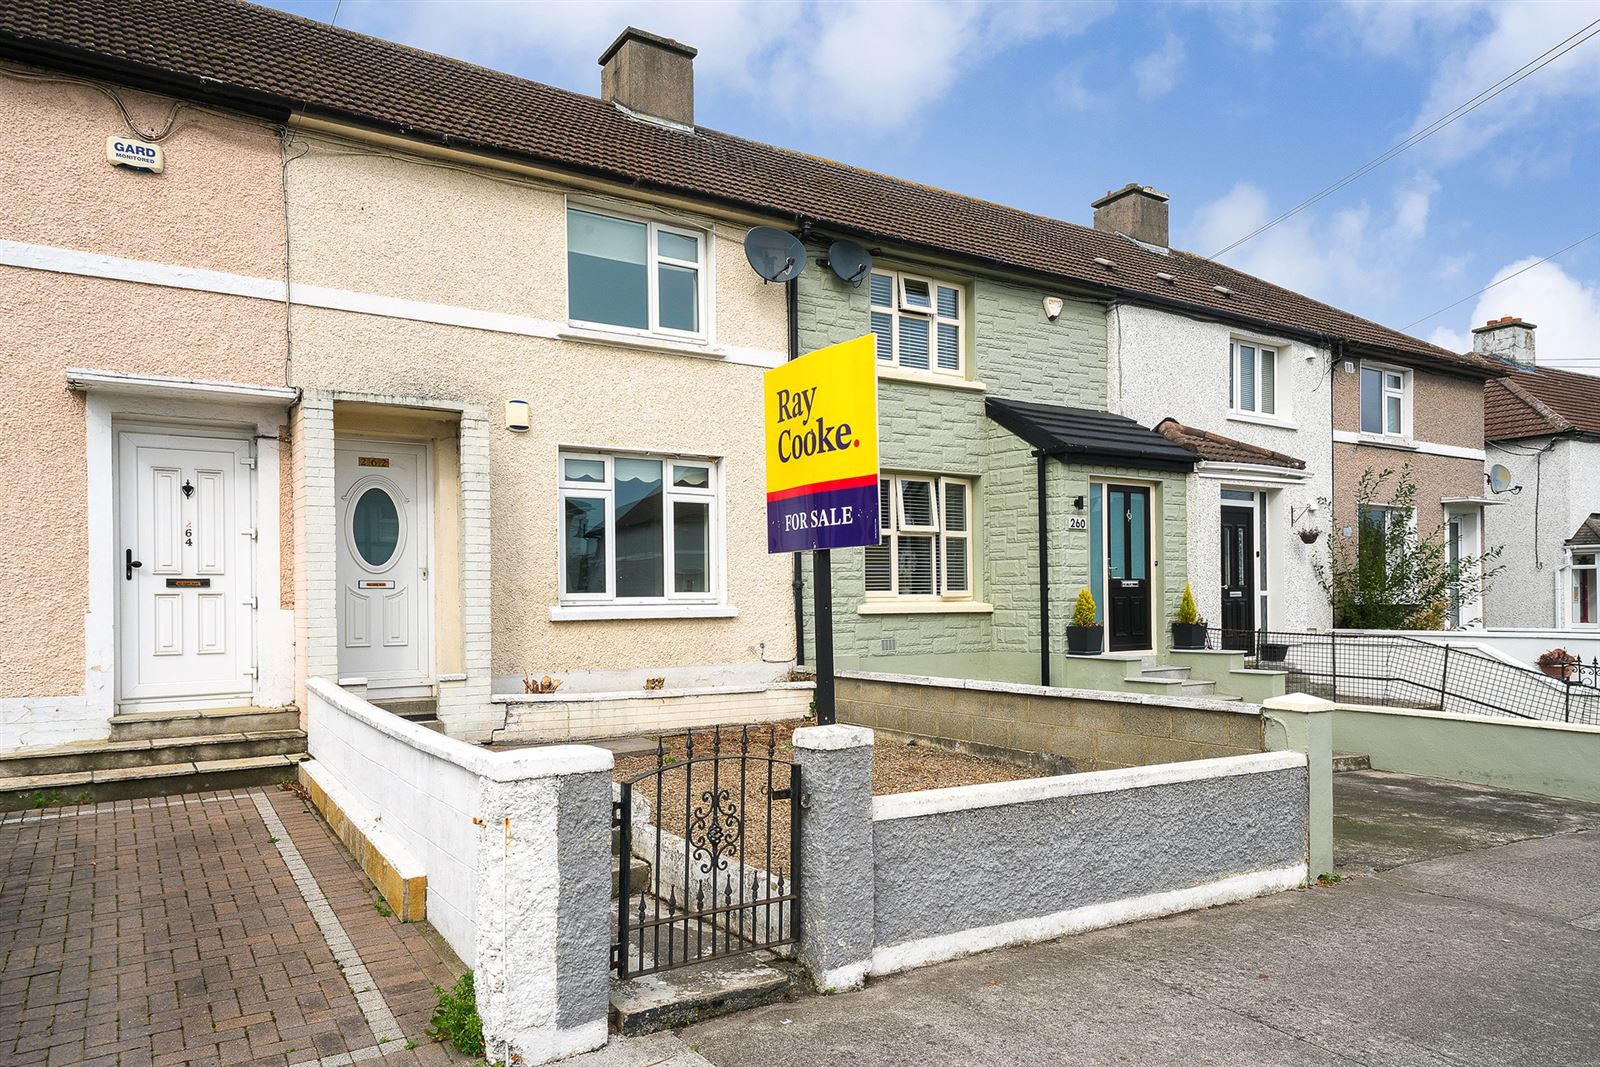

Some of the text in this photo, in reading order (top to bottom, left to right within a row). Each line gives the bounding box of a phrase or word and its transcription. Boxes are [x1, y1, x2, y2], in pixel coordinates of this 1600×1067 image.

[114, 142, 156, 157] GARD
[116, 153, 155, 164] MONITORED
[777, 386, 817, 426] Ray
[778, 416, 860, 464] Cooke.
[784, 506, 853, 532] FOR SALE
[1070, 518, 1086, 529] 260
